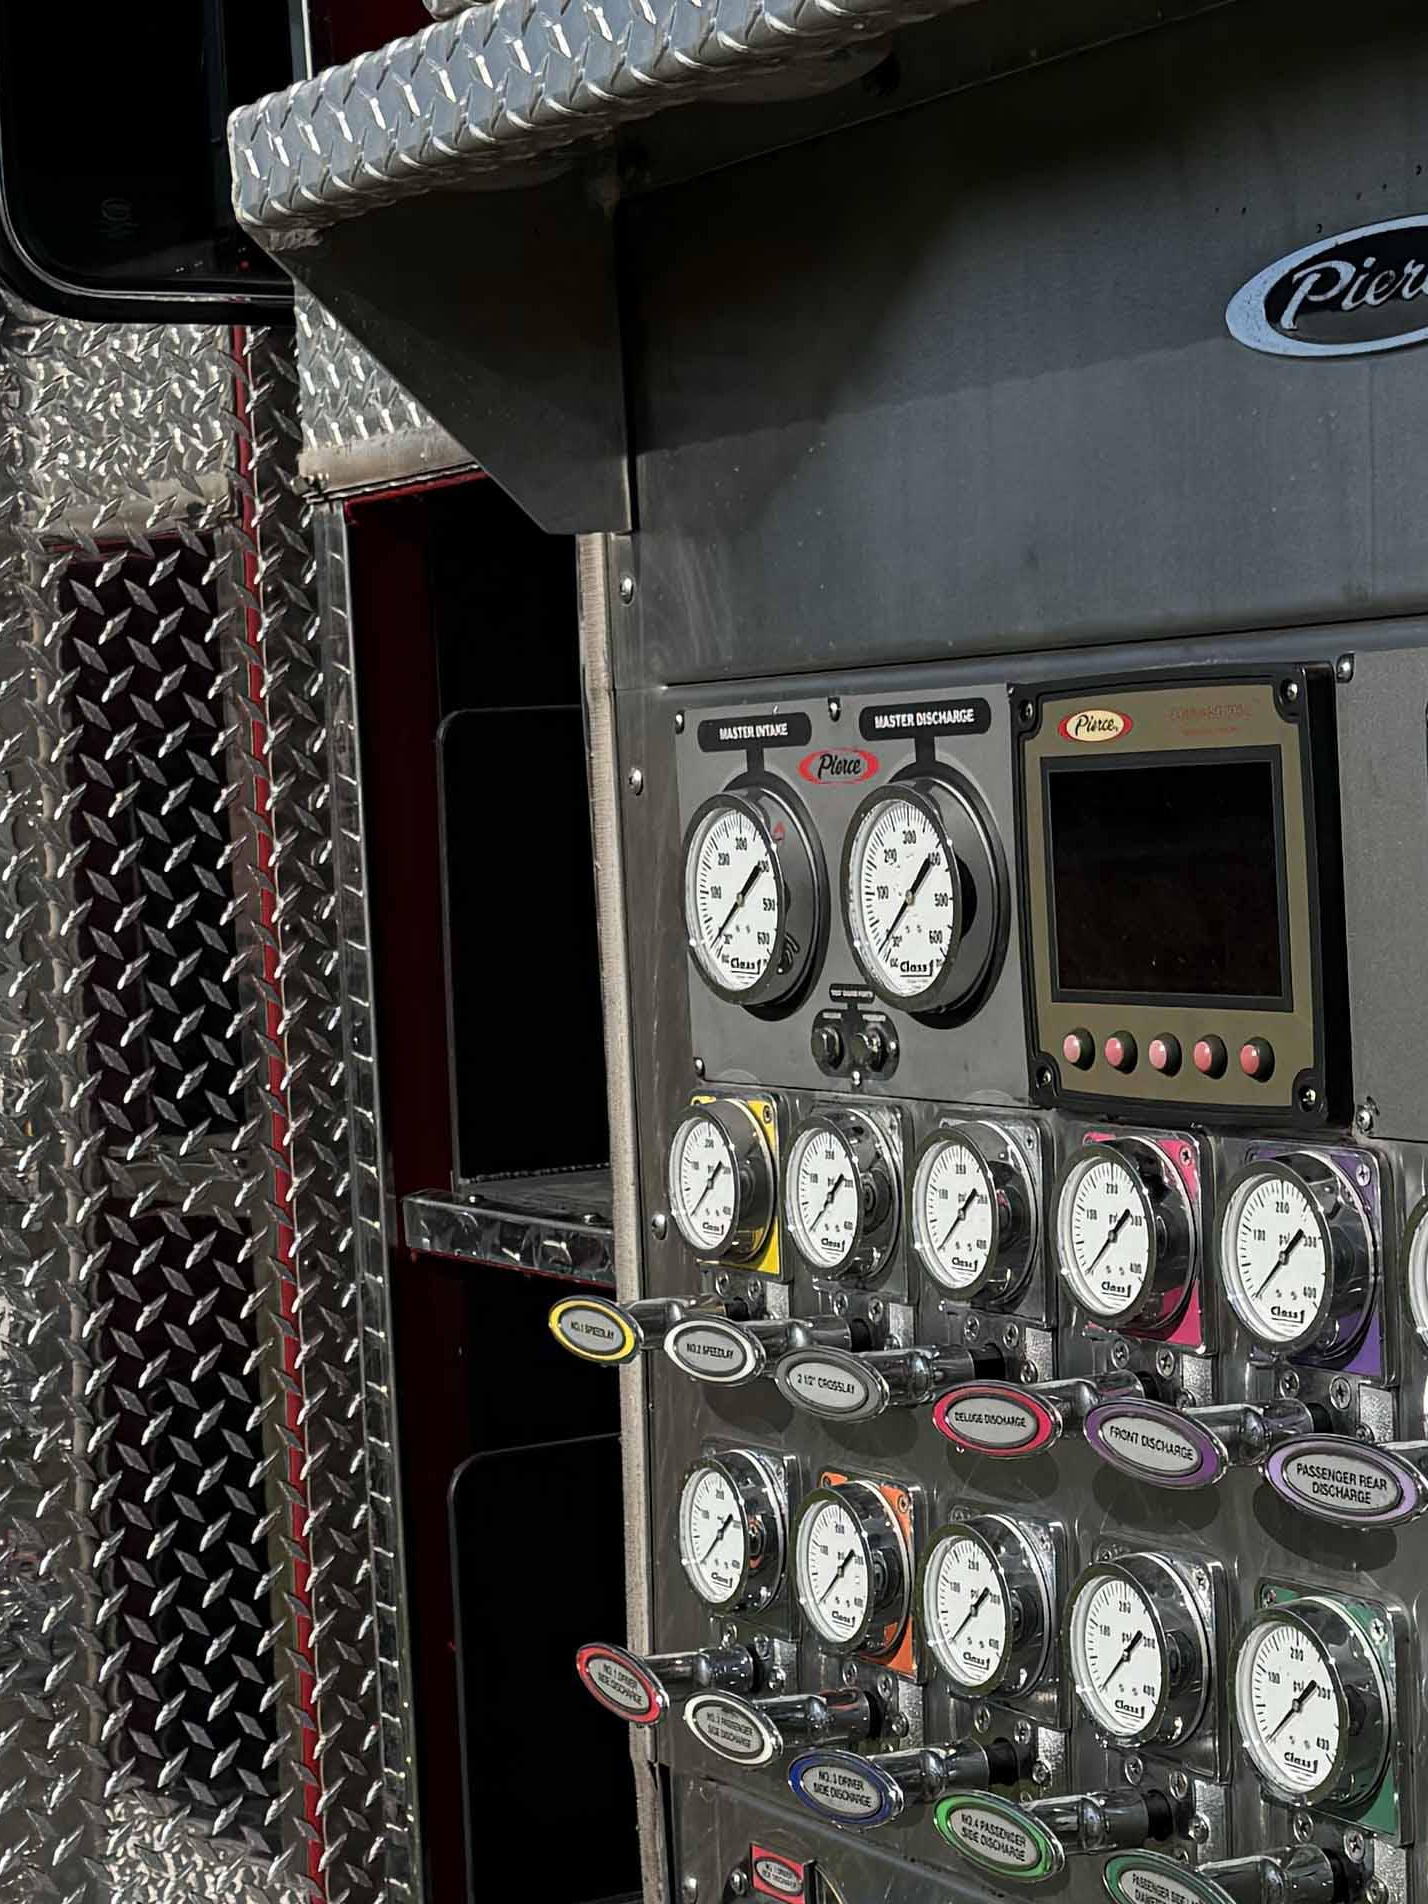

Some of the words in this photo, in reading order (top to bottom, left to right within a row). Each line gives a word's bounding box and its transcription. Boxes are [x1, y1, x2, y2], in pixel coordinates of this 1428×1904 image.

[874, 712, 915, 729] MASTER
[917, 708, 975, 726] DISCHARGE
[1075, 714, 1118, 736] Pierce
[719, 725, 755, 740] MASTER
[756, 723, 788, 738] INTAKE
[818, 753, 862, 777] Pierce
[934, 893, 949, 908] 500
[817, 1377, 855, 1395] CROSSLAY
[955, 1411, 983, 1426] DELUGE
[984, 1412, 1027, 1429] DISCHARGE
[1109, 1425, 1139, 1448] FRONT
[1140, 1436, 1194, 1463] DISCHARGE
[1296, 1463, 1356, 1486] PASSENGER
[1357, 1474, 1388, 1492] REAR
[1311, 1481, 1372, 1505] DISCHARGE
[980, 1820, 1026, 1848] PASSENGER
[980, 1834, 1026, 1862] DISCHARGE
[1132, 1873, 1170, 1901] PASSENGER
